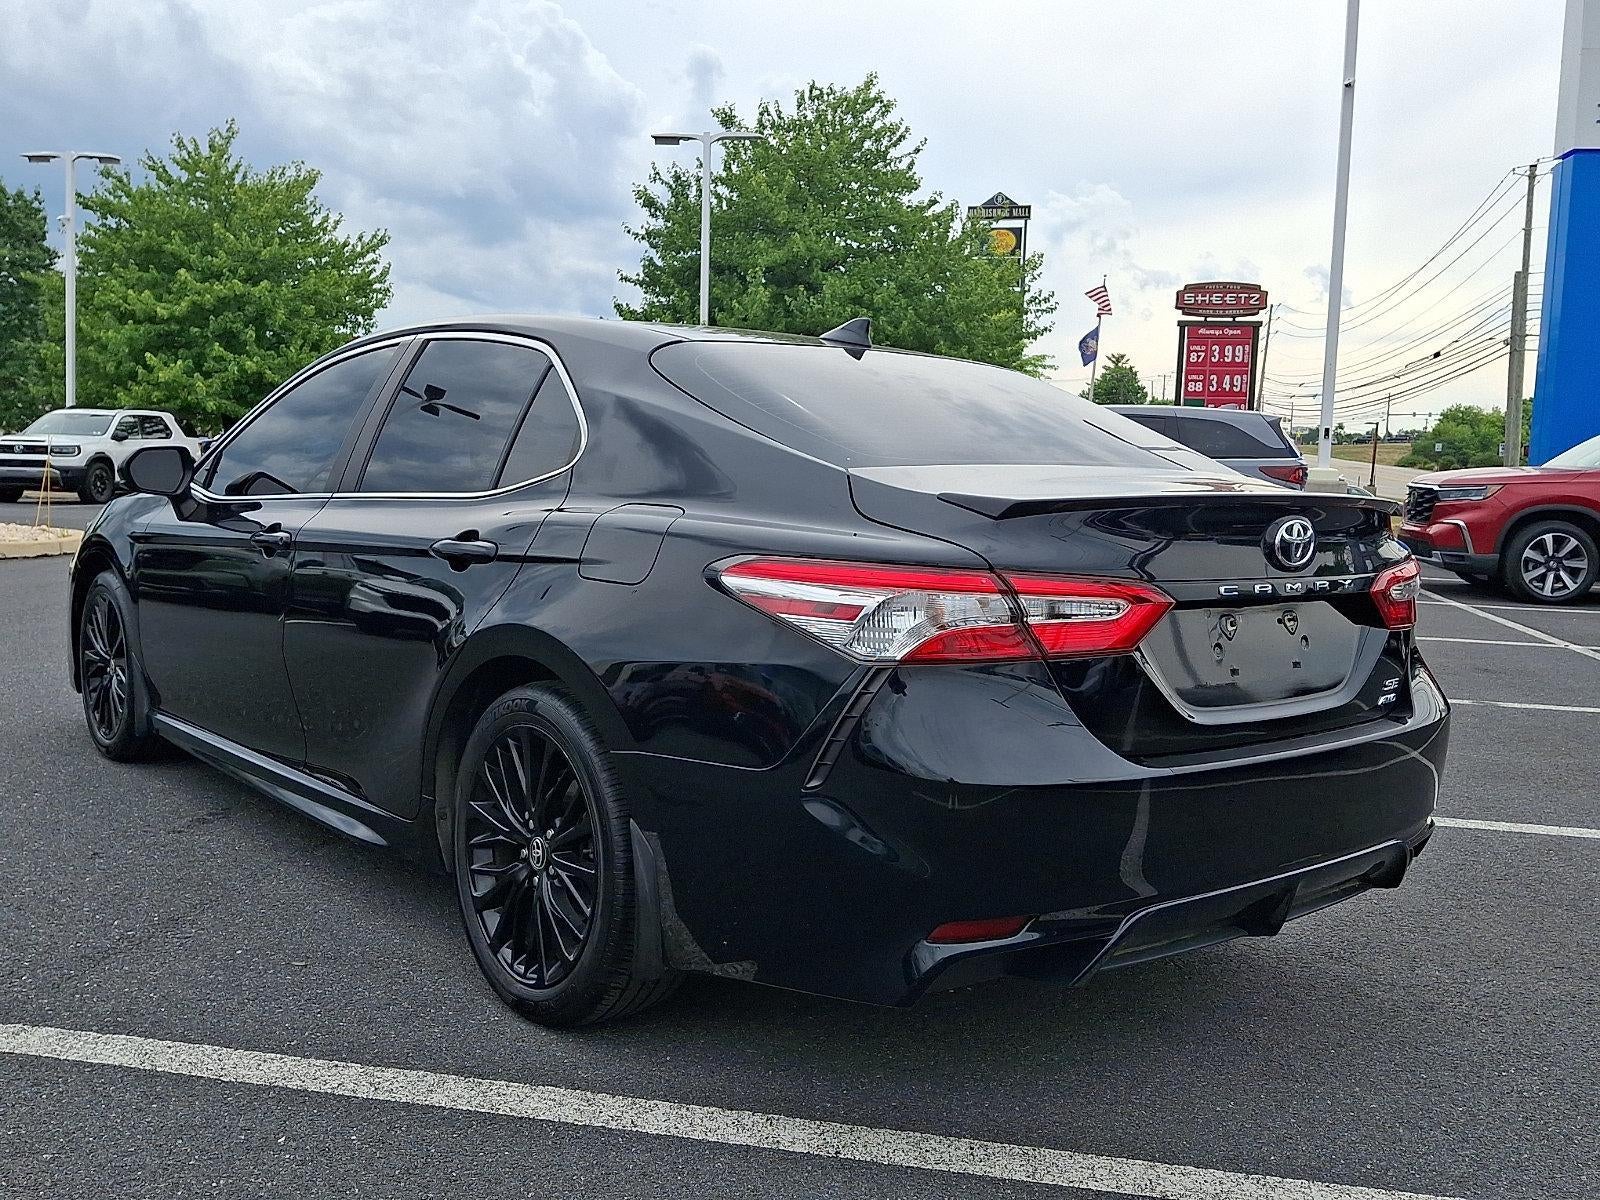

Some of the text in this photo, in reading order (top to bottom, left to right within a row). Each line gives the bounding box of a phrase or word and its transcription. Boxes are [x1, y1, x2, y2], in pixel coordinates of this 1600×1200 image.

[1183, 293, 1261, 305] SHEETZ
[1198, 328, 1242, 336] Always Open
[1189, 352, 1205, 363] 87
[1187, 381, 1203, 392] 88
[1218, 579, 1354, 596] CAMRY
[1381, 677, 1400, 691] SE
